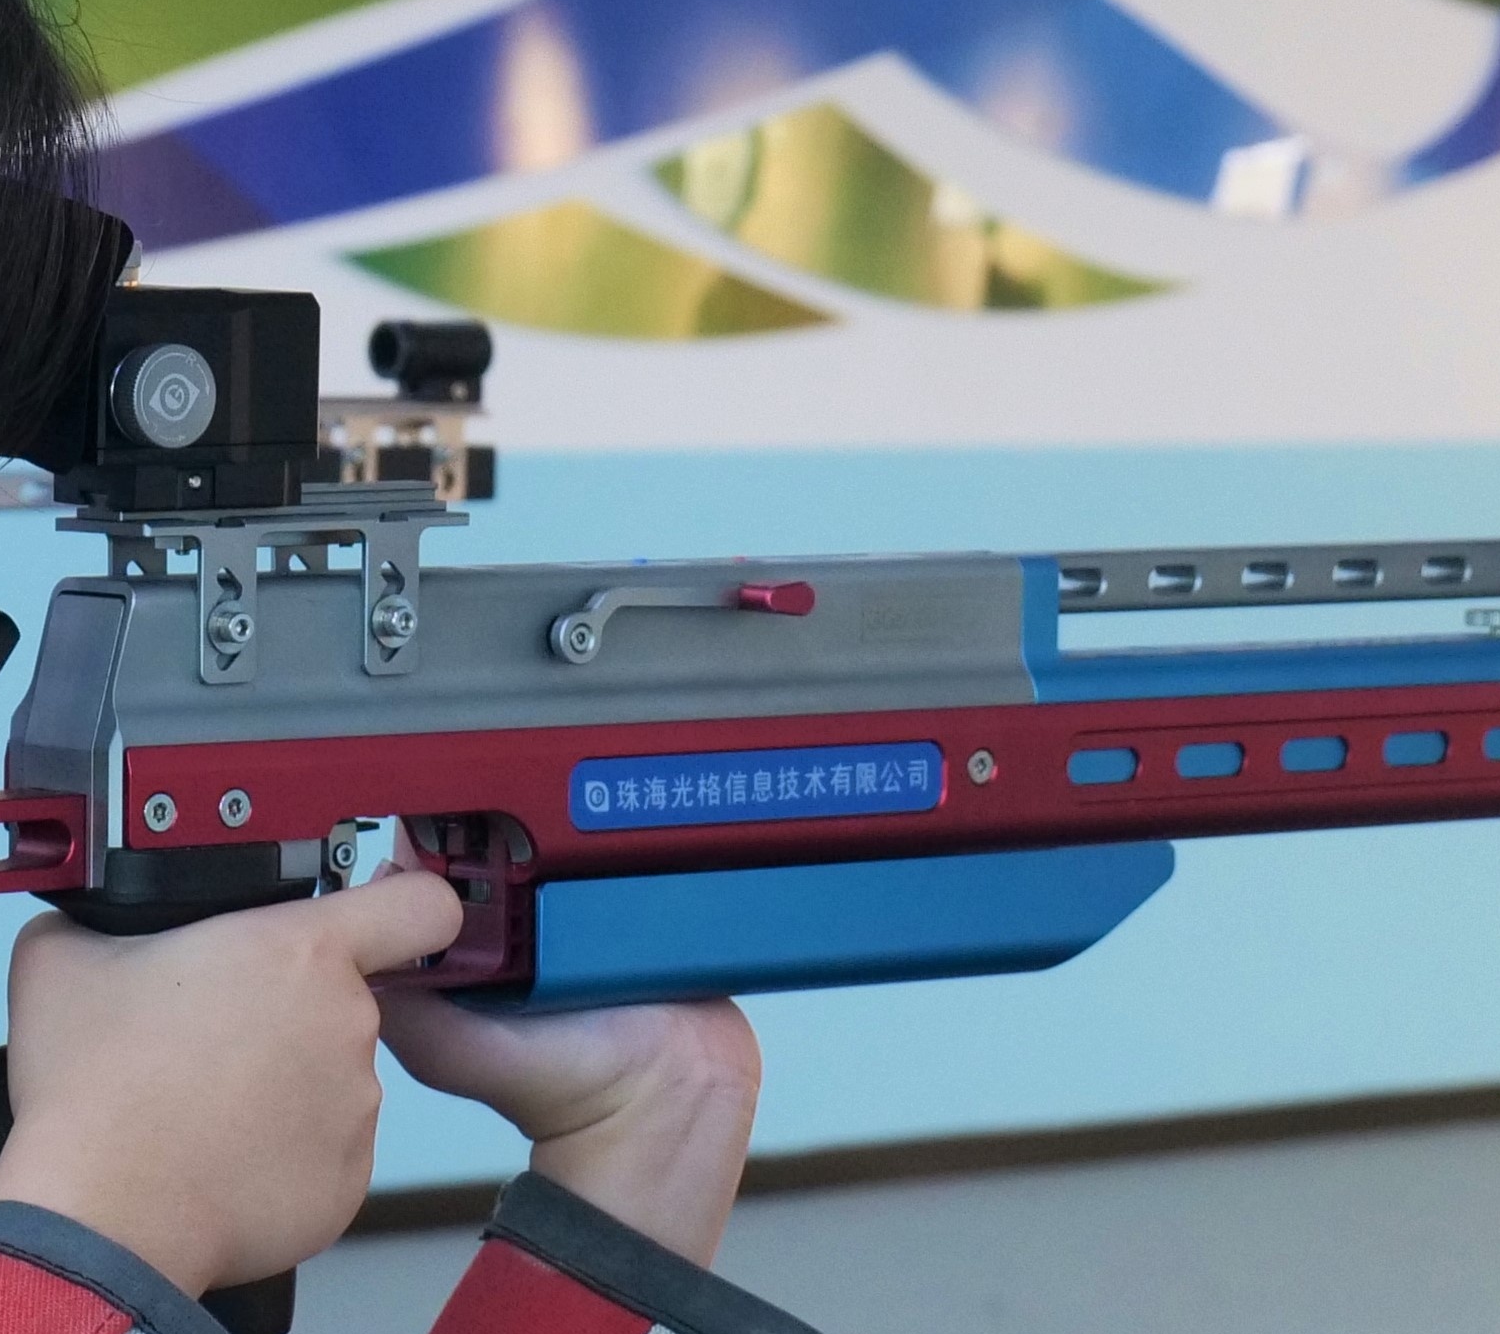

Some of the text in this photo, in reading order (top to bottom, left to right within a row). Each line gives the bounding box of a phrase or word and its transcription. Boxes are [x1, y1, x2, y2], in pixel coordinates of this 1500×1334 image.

[616, 759, 930, 814] 珠海光格信息技术有限公司
